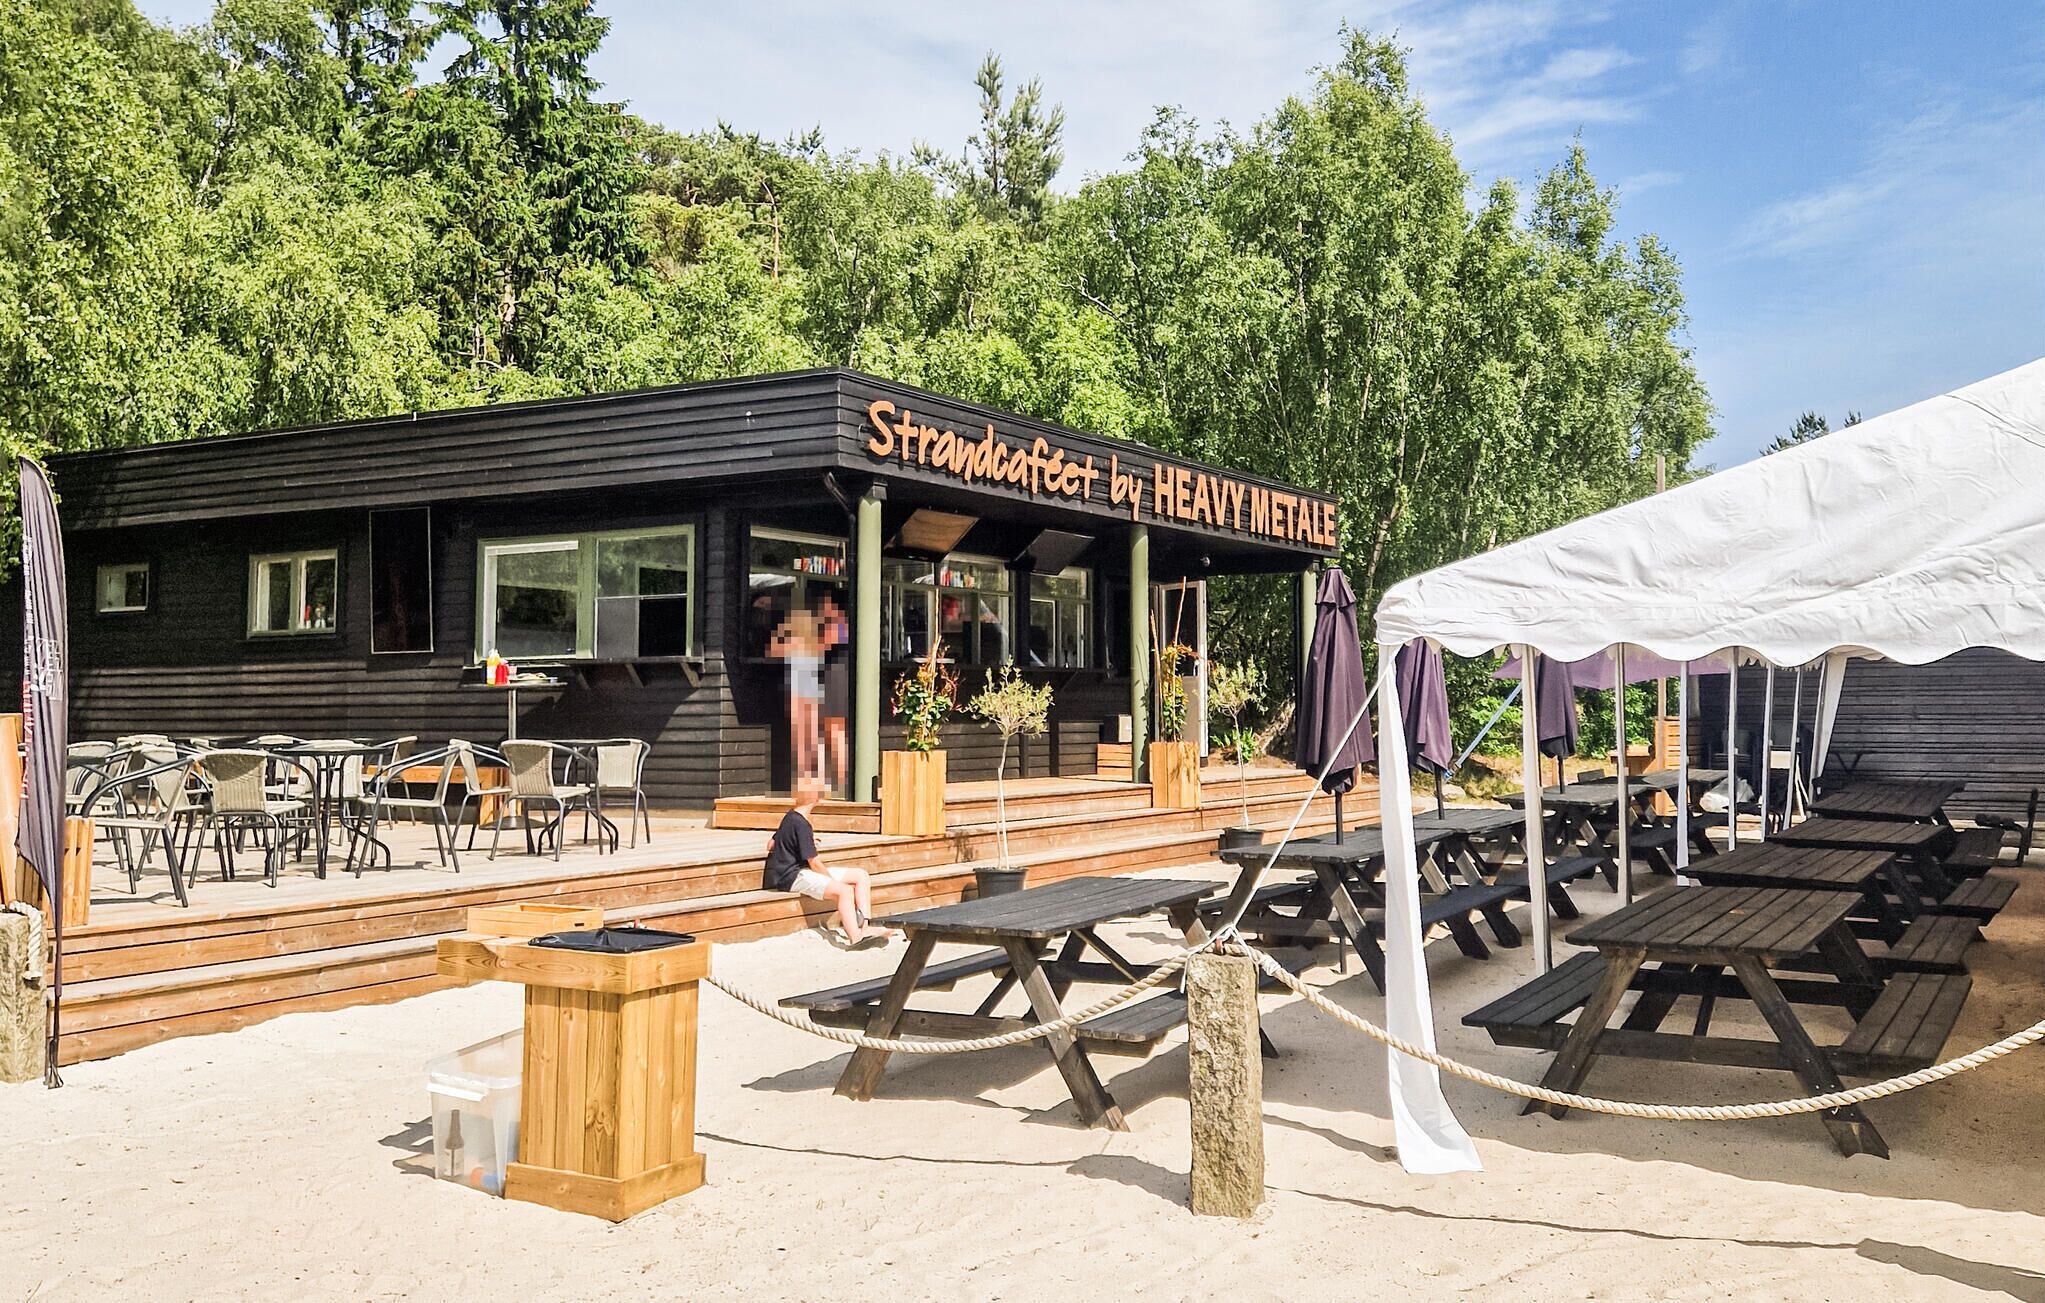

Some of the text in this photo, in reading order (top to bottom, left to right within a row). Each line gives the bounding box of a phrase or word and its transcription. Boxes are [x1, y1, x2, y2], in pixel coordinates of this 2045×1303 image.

[868, 400, 1337, 546] Strandcaféet by HEAVY METALE
